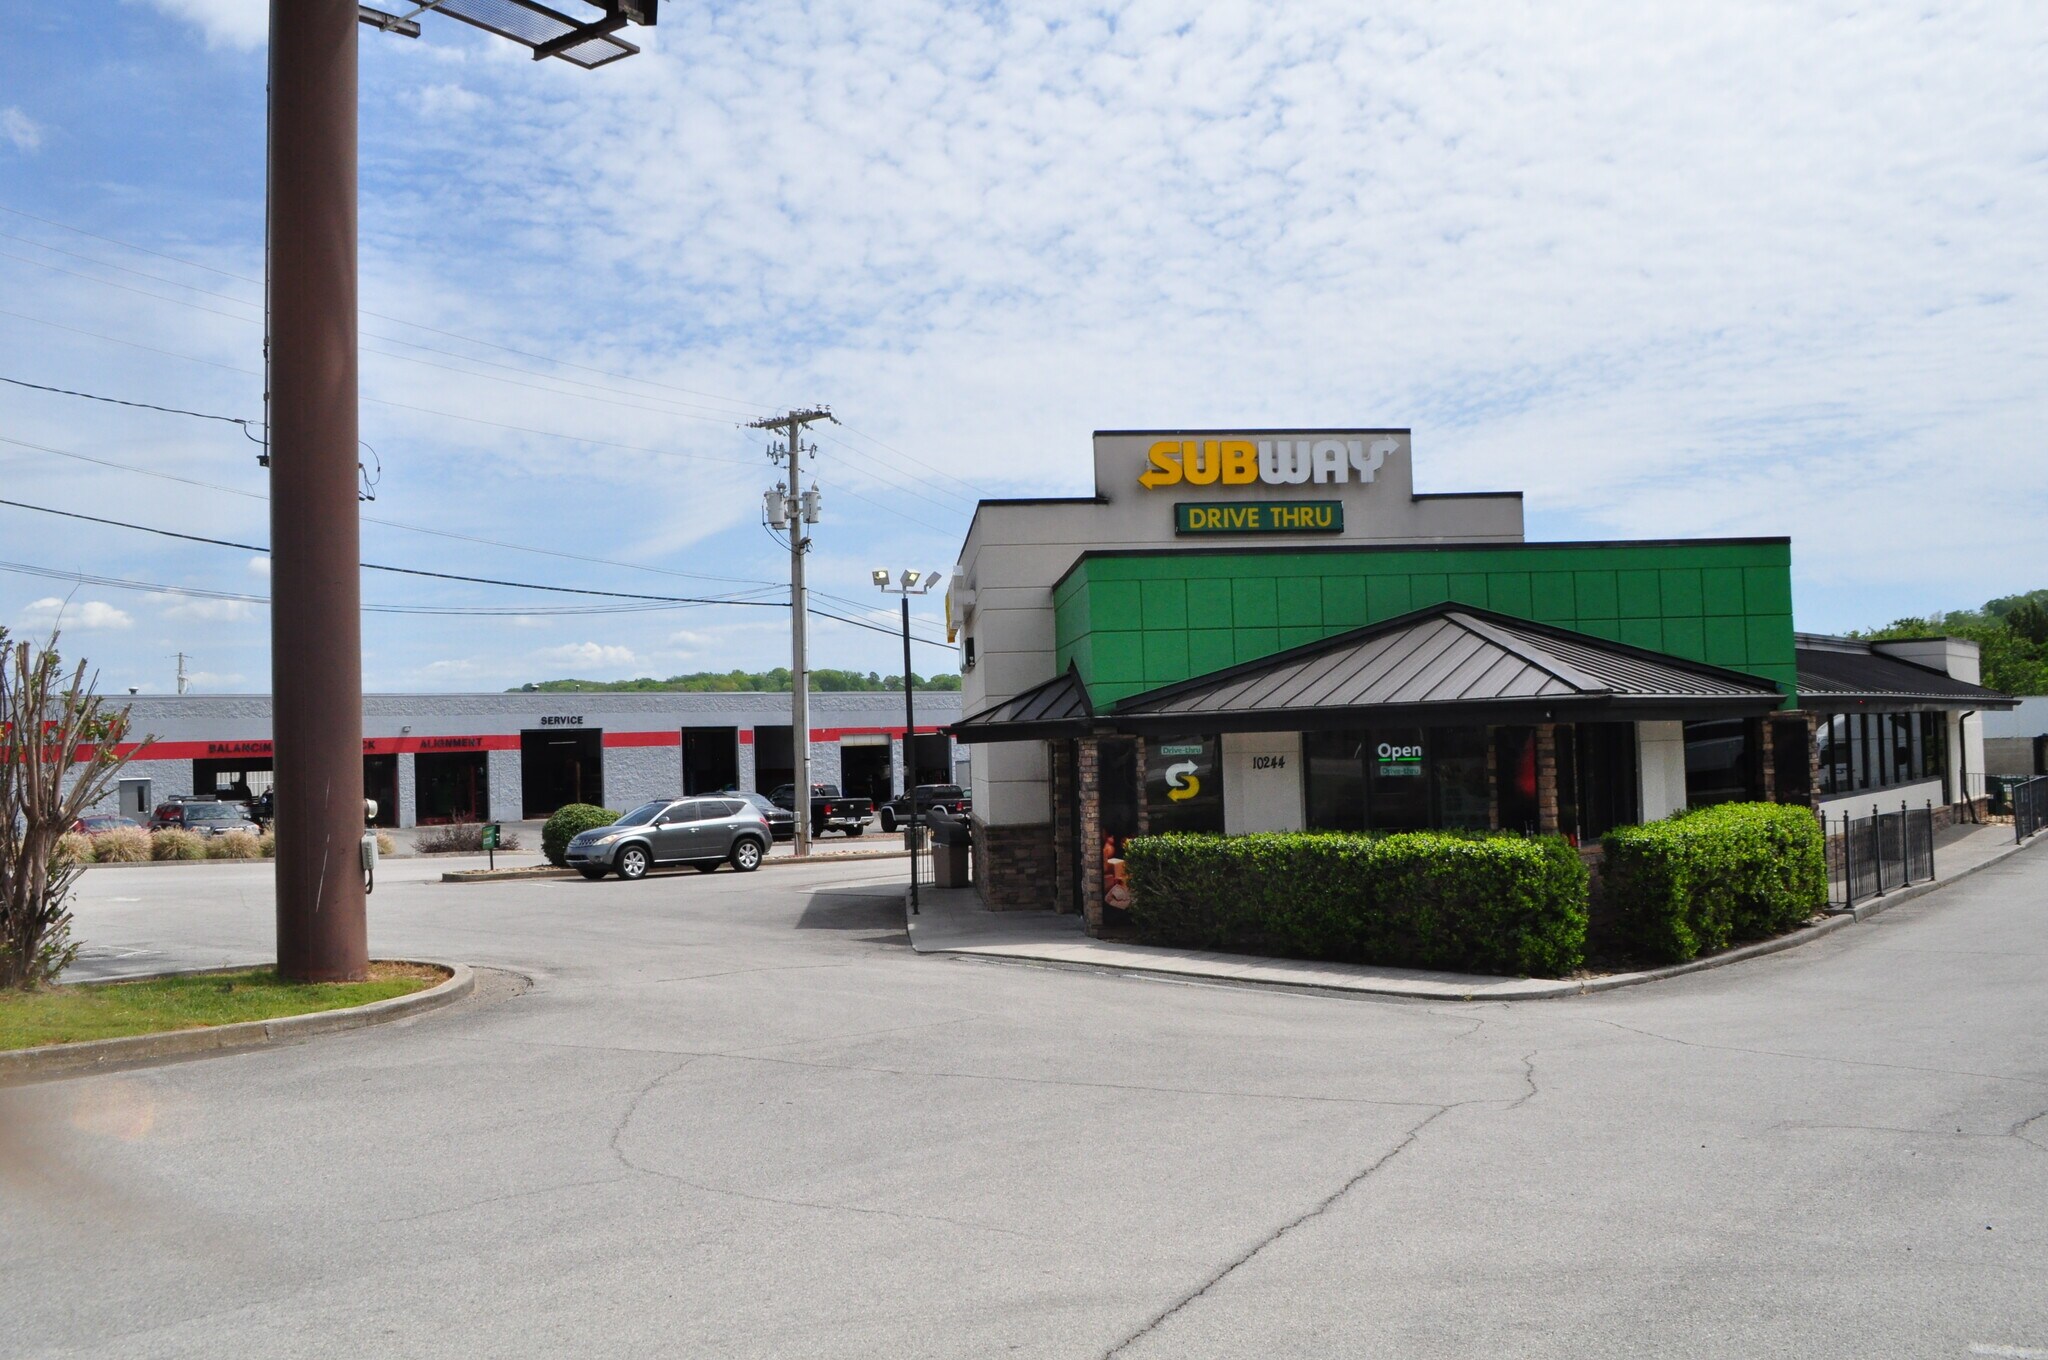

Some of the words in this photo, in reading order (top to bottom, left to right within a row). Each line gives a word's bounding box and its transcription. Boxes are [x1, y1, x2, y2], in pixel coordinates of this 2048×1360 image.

[1137, 435, 1400, 490] SUBWAY
[1189, 508, 1259, 529] DRIVE
[1270, 507, 1332, 527] THRU
[541, 716, 583, 725] SERVICE
[208, 743, 273, 754] BALANCIN
[421, 738, 482, 748] ALIGNMENT
[1377, 743, 1422, 761] Open
[1252, 756, 1286, 769] 10244
